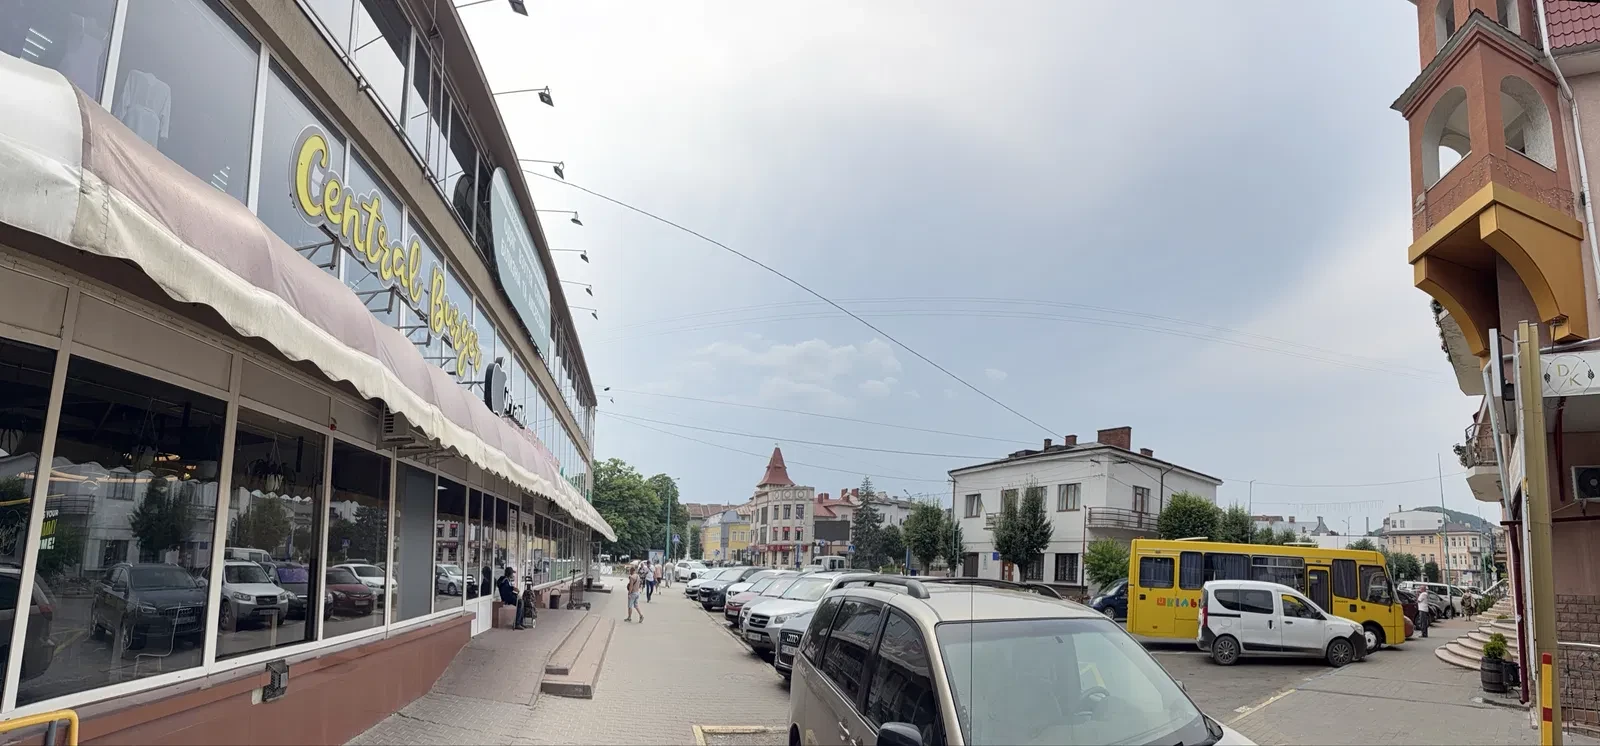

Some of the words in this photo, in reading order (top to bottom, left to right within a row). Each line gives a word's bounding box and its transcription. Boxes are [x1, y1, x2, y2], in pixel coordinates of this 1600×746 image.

[295, 133, 424, 303] Central
[429, 266, 482, 377] Burger
[1557, 364, 1570, 377] D
[1570, 373, 1582, 386] K
[46, 509, 59, 518] YOUR
[40, 537, 55, 549] ME!
